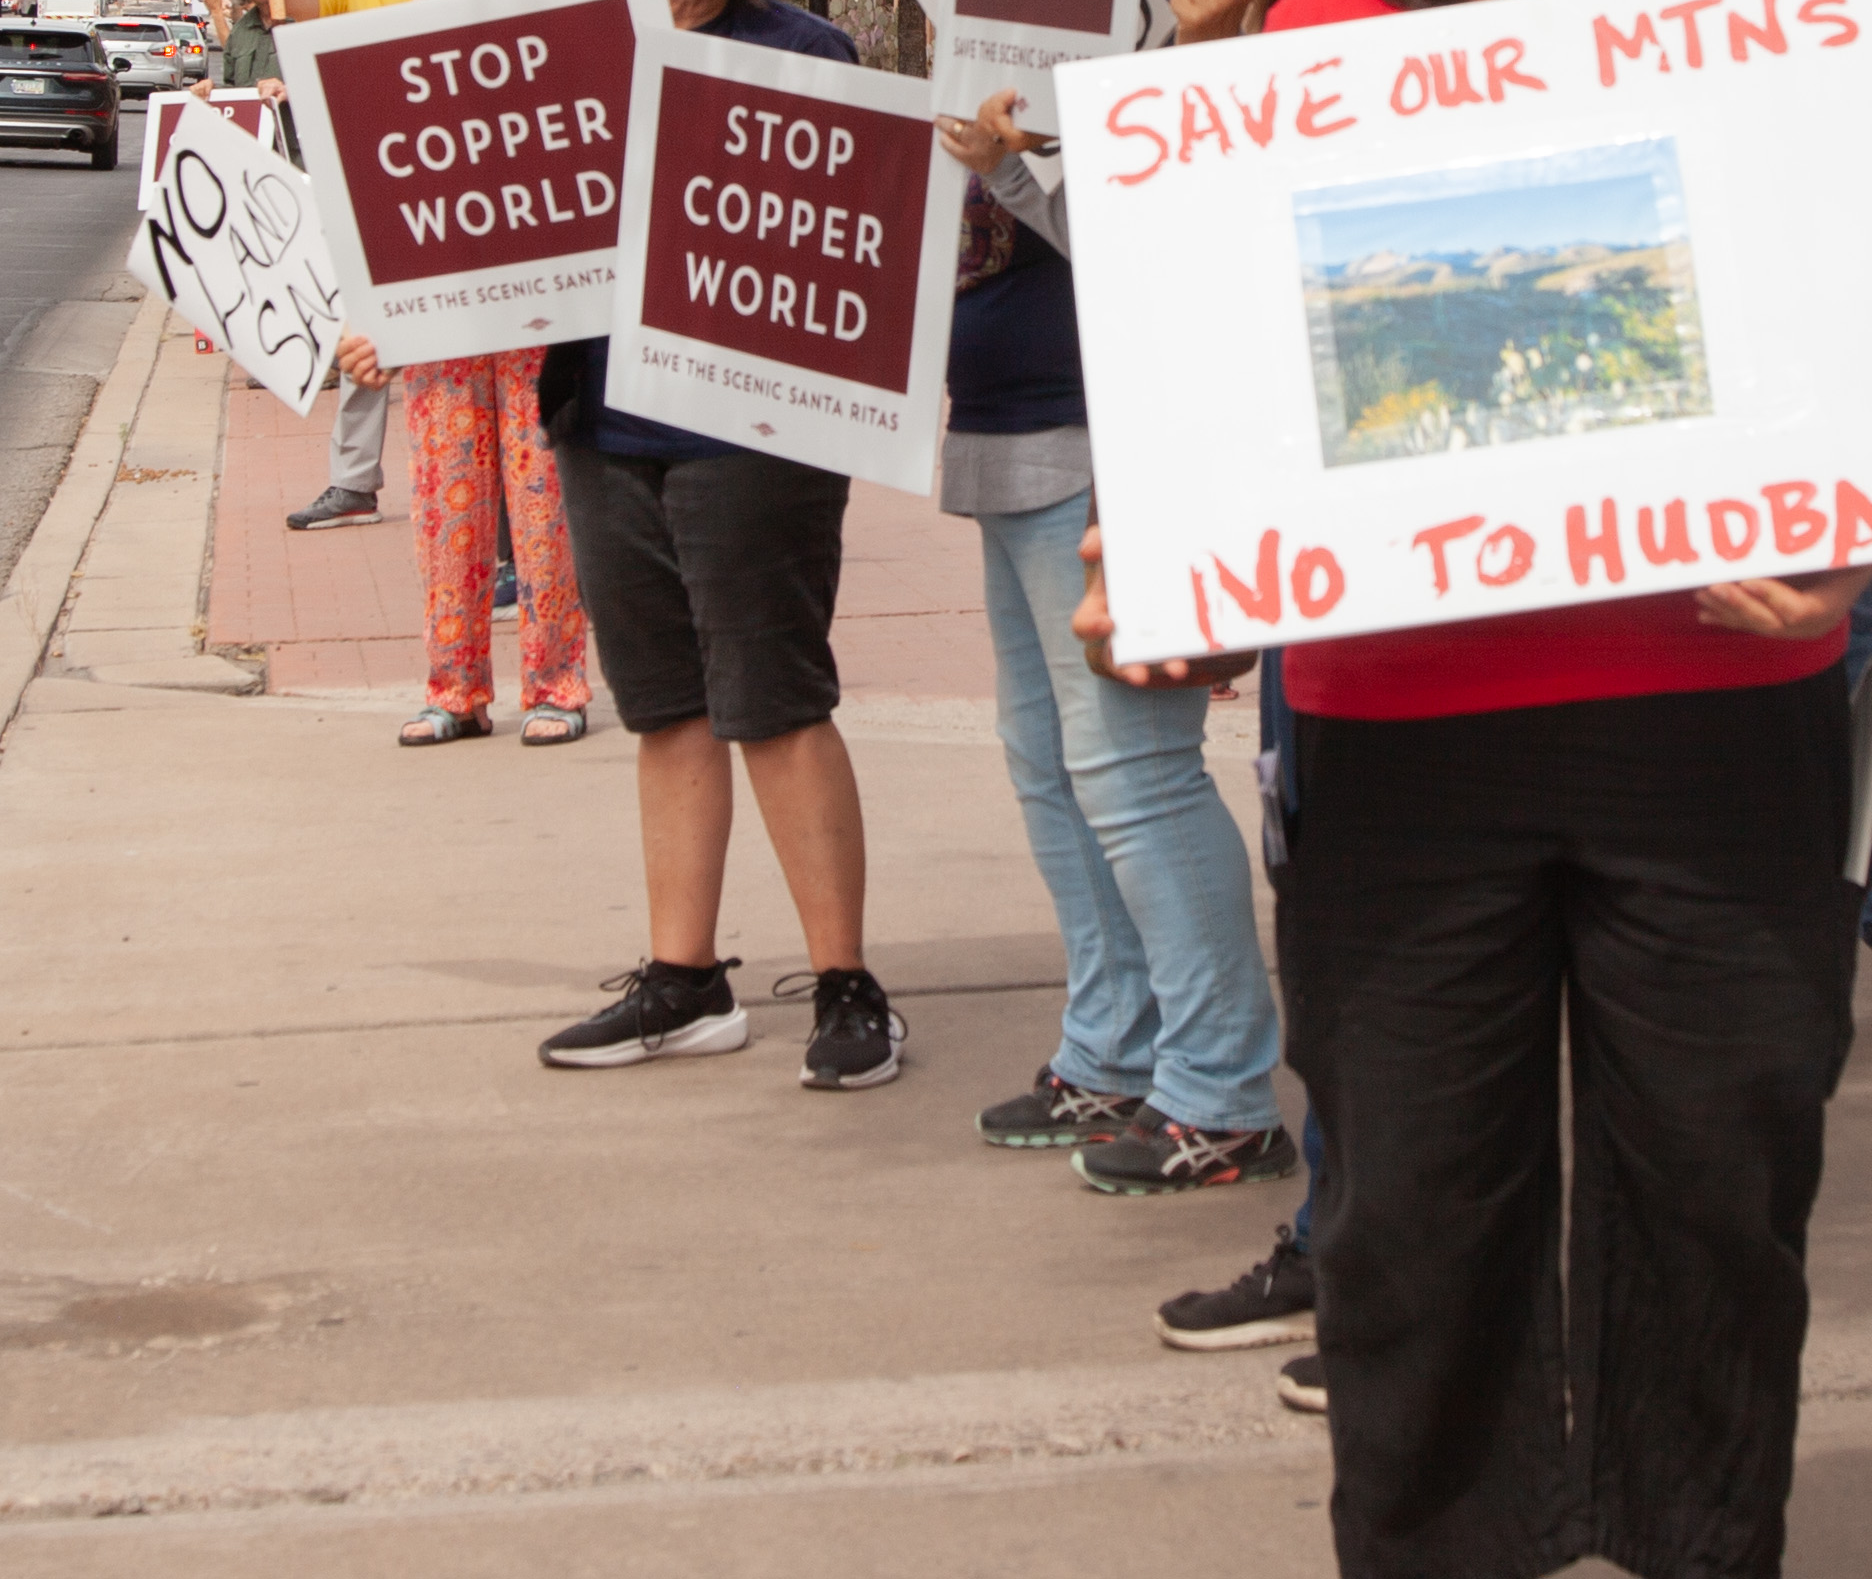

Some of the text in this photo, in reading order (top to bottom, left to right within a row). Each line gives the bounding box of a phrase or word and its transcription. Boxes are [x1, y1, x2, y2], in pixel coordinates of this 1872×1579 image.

[400, 35, 549, 104] STOP
[1104, 57, 1358, 187] SAVE
[1389, 37, 1548, 117] OUR
[378, 97, 613, 178] COPPER
[724, 104, 855, 177] STOP
[148, 149, 227, 302] NO
[399, 170, 616, 246] WORLD
[683, 175, 884, 269] COPPER
[193, 169, 301, 350] LAND
[383, 267, 617, 318] SAVE THE SCENIC SANTA
[685, 251, 868, 342] WORLD
[641, 346, 900, 433] SAVE THE SCENIC SANTA RITAS
[1190, 528, 1347, 652] NO
[1413, 514, 1536, 598] TO
